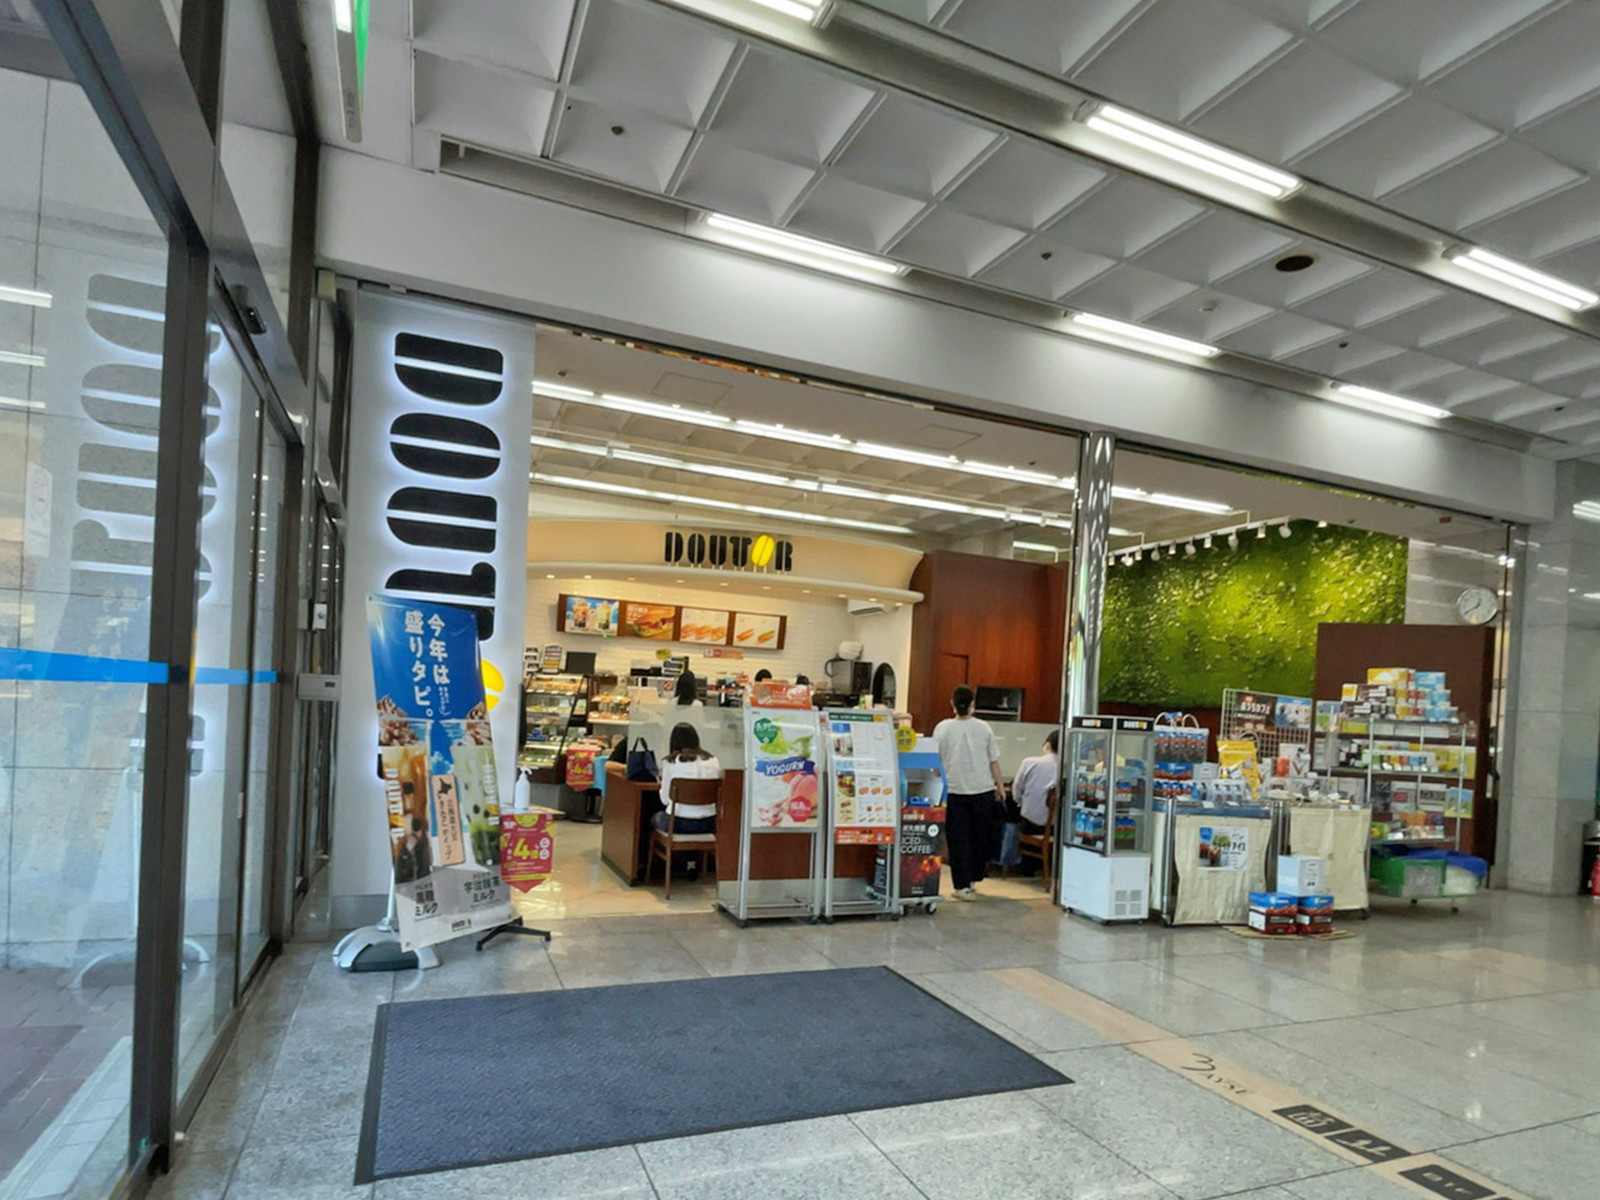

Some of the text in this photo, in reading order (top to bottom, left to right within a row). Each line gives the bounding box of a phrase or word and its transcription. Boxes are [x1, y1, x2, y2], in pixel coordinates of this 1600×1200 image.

[384, 331, 504, 712] DOUT
[664, 531, 794, 572] DOUTOR
[404, 610, 434, 717] 盛りタピ。
[427, 613, 451, 685] 今年は
[900, 845, 931, 854] COFFEE
[902, 836, 921, 845] ICED
[415, 902, 438, 917] ミルク
